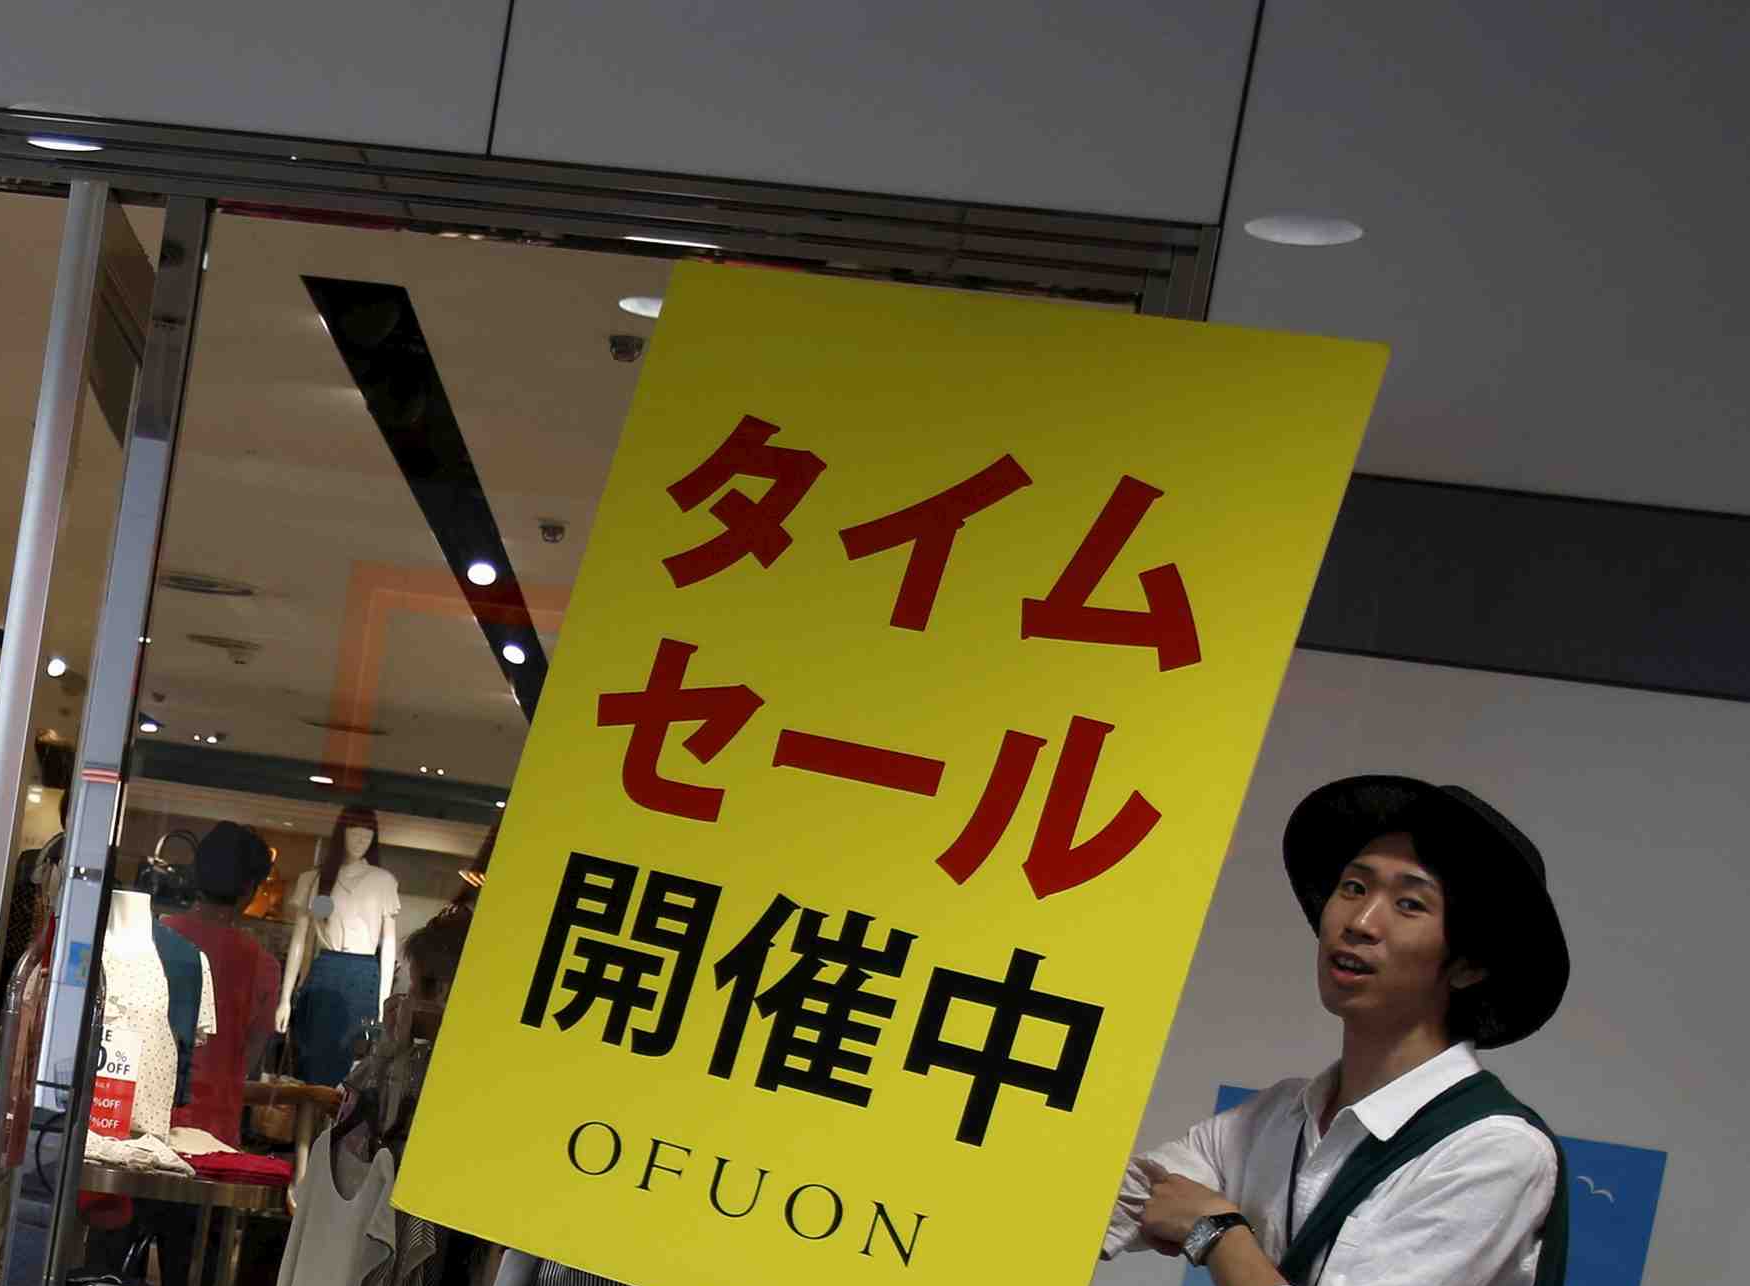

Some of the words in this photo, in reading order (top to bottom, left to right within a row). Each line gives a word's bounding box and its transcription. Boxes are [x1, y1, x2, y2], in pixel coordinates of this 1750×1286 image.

[660, 413, 1202, 673] タイム
[596, 636, 1163, 900] セール
[106, 1062, 131, 1075] OFF
[519, 850, 1105, 1148] 開催中
[566, 1120, 928, 1268] OFUON
